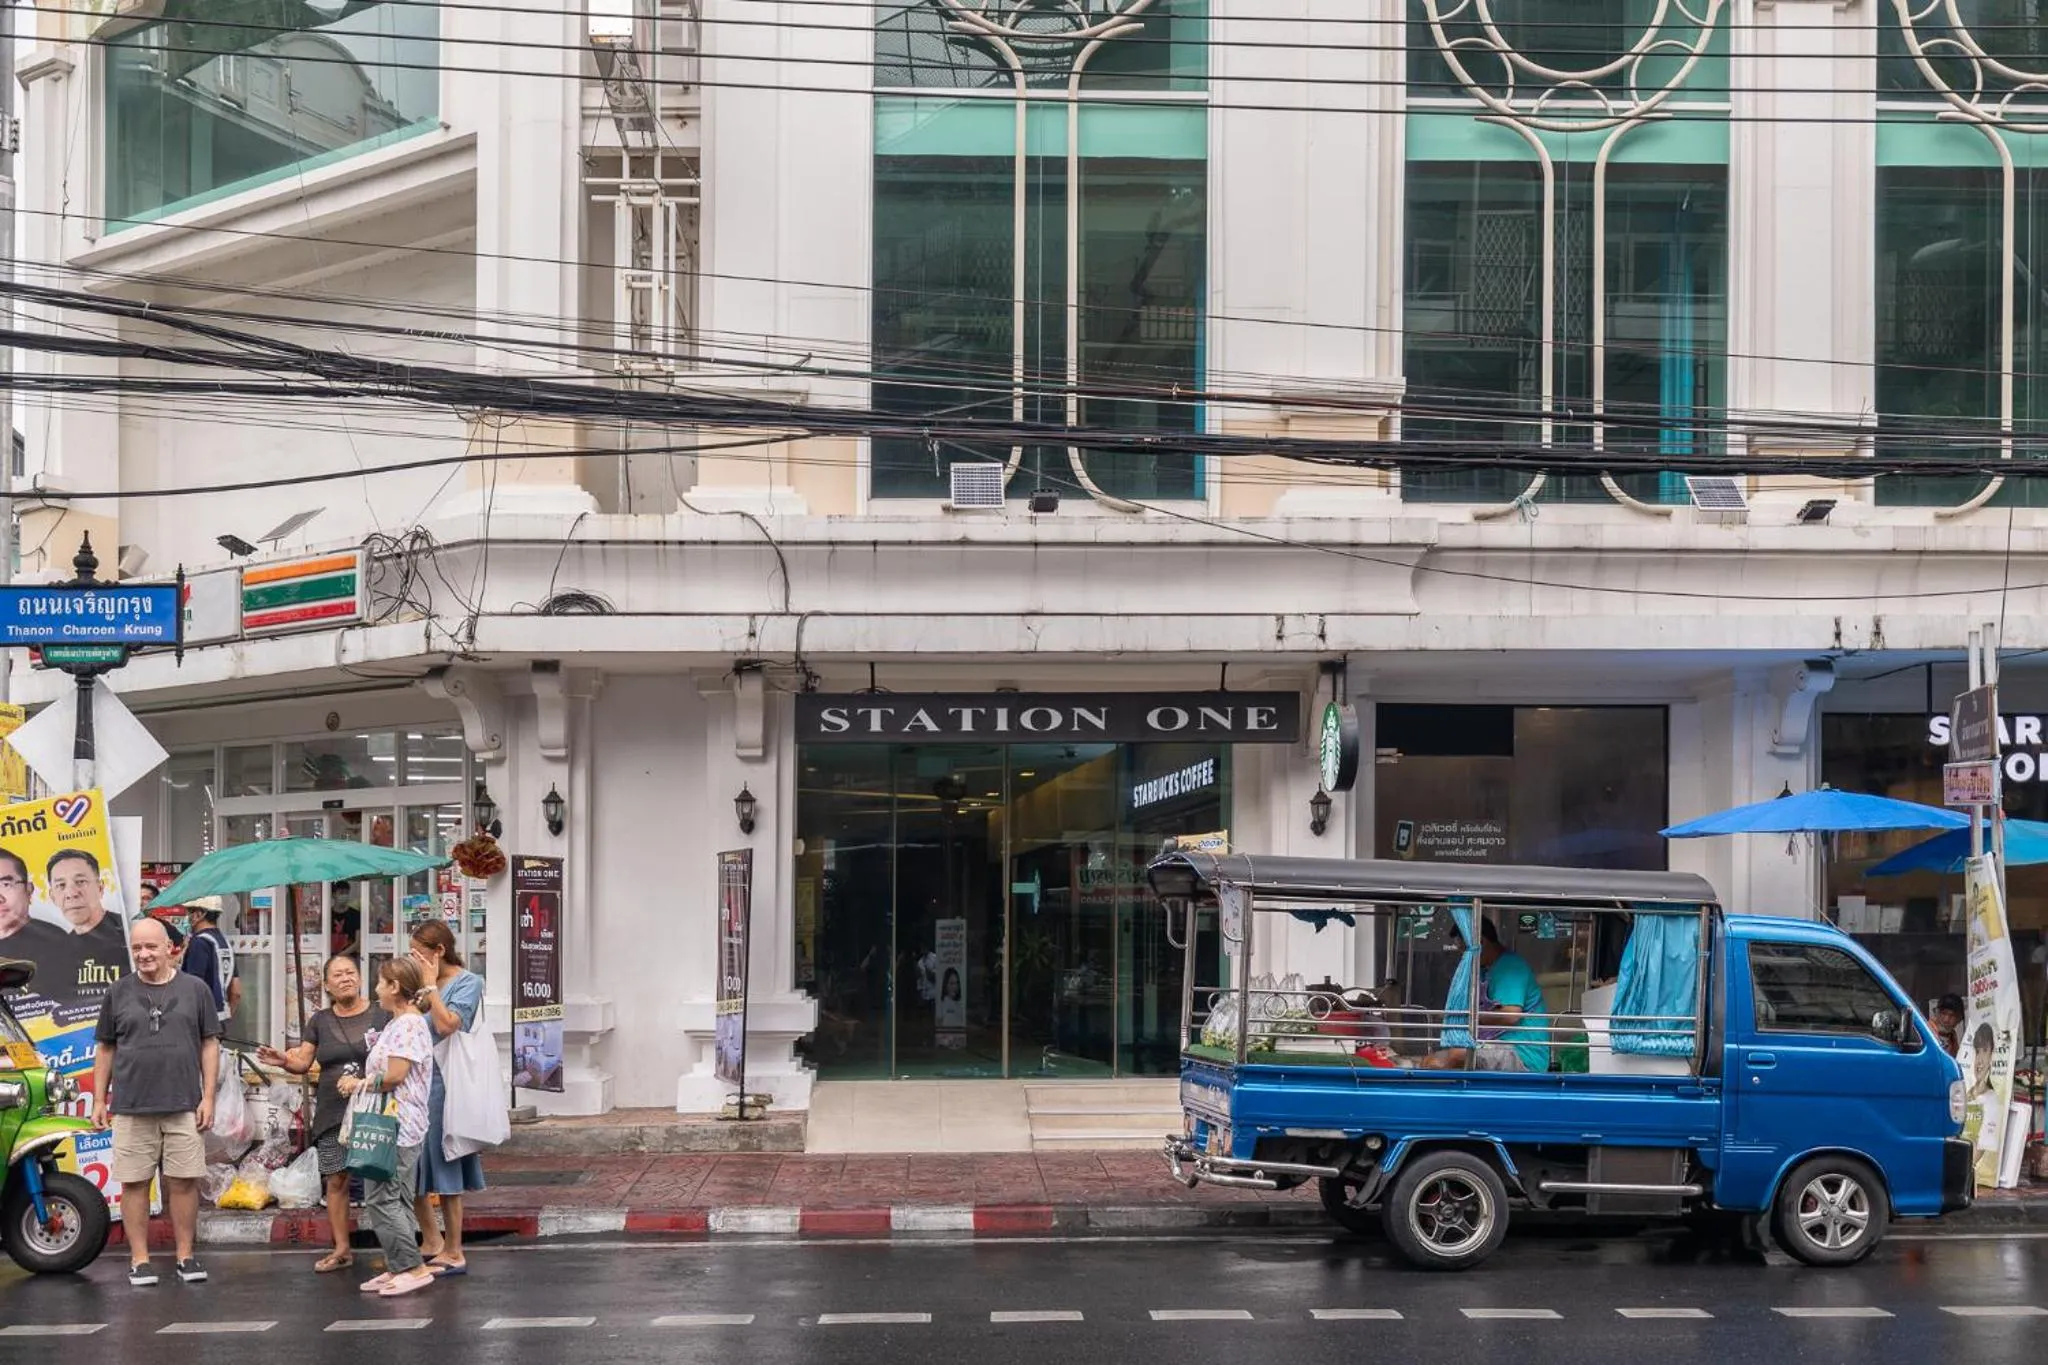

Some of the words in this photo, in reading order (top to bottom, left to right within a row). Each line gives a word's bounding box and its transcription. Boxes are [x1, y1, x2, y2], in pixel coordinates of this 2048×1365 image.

[18, 591, 153, 621] ถนนเจริญกรุง
[7, 625, 53, 636] Thanon
[62, 625, 116, 636] Charoen
[124, 624, 162, 636] Krung
[820, 707, 1111, 732] STATION
[1146, 706, 1278, 731] ONE
[1928, 715, 2043, 745] SR
[1133, 771, 1180, 808] STARBUCKS
[1180, 758, 1214, 793] COFFEE
[352, 1141, 377, 1152] DAY
[354, 1131, 393, 1144] EVERY
